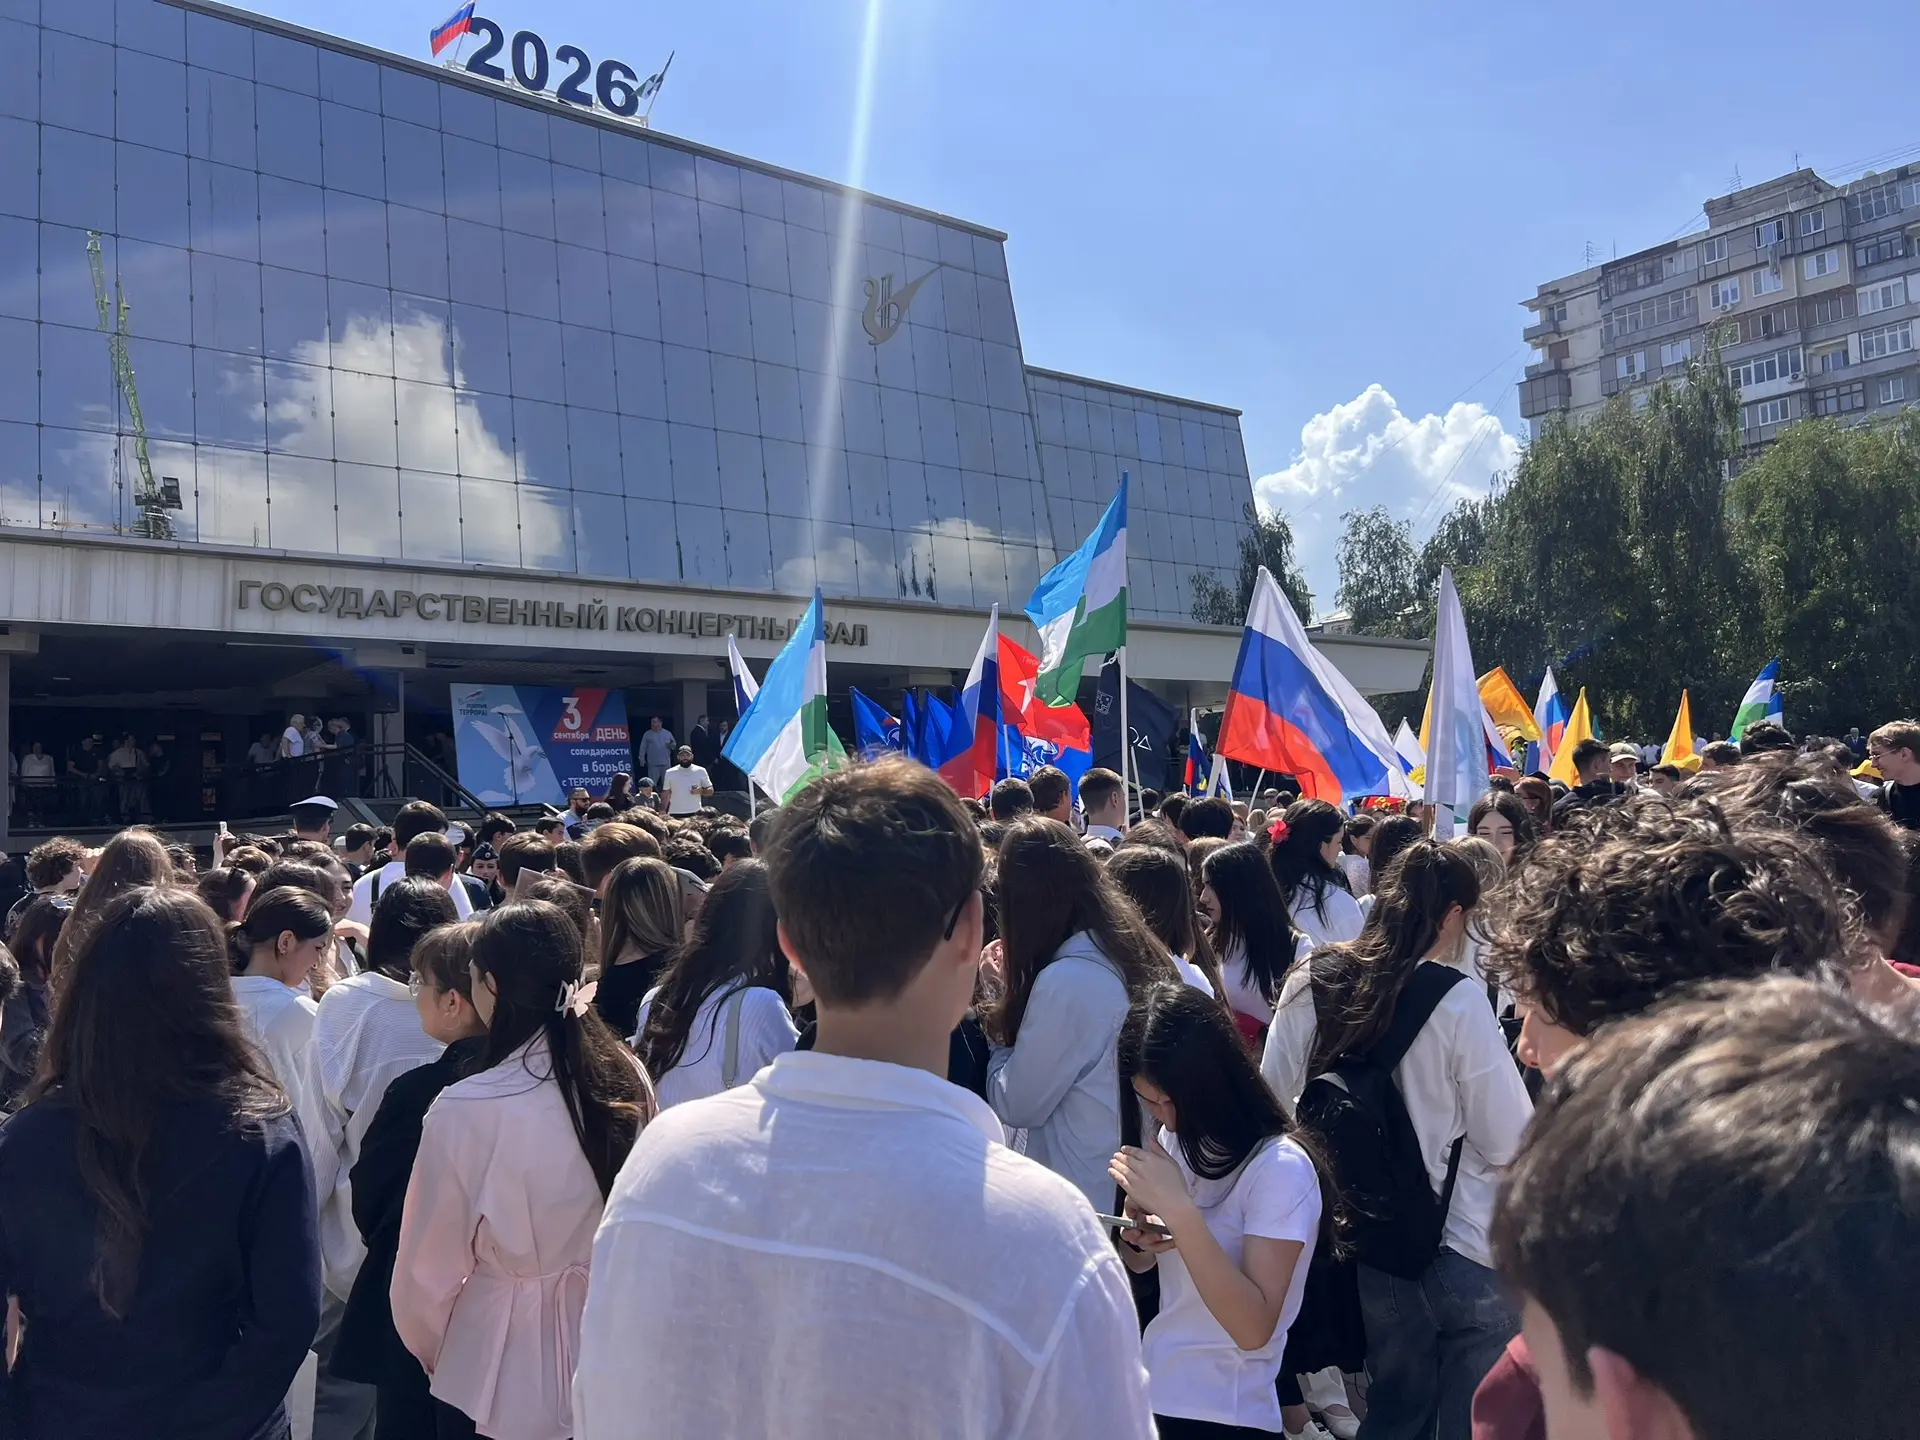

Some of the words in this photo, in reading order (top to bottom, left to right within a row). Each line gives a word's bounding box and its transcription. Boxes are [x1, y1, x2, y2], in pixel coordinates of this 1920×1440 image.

[465, 16, 640, 117] 2026
[238, 580, 609, 630] ГОСУДАРСТВЕННЫЙ
[562, 696, 582, 730] 3
[553, 730, 590, 742] сентября
[595, 727, 628, 742] ДЕНЬ
[570, 747, 630, 758] солидарности
[582, 763, 590, 773] в
[591, 760, 632, 775] борьбе
[561, 779, 568, 787] с
[567, 776, 613, 787] ТЕРРОРИЗ
